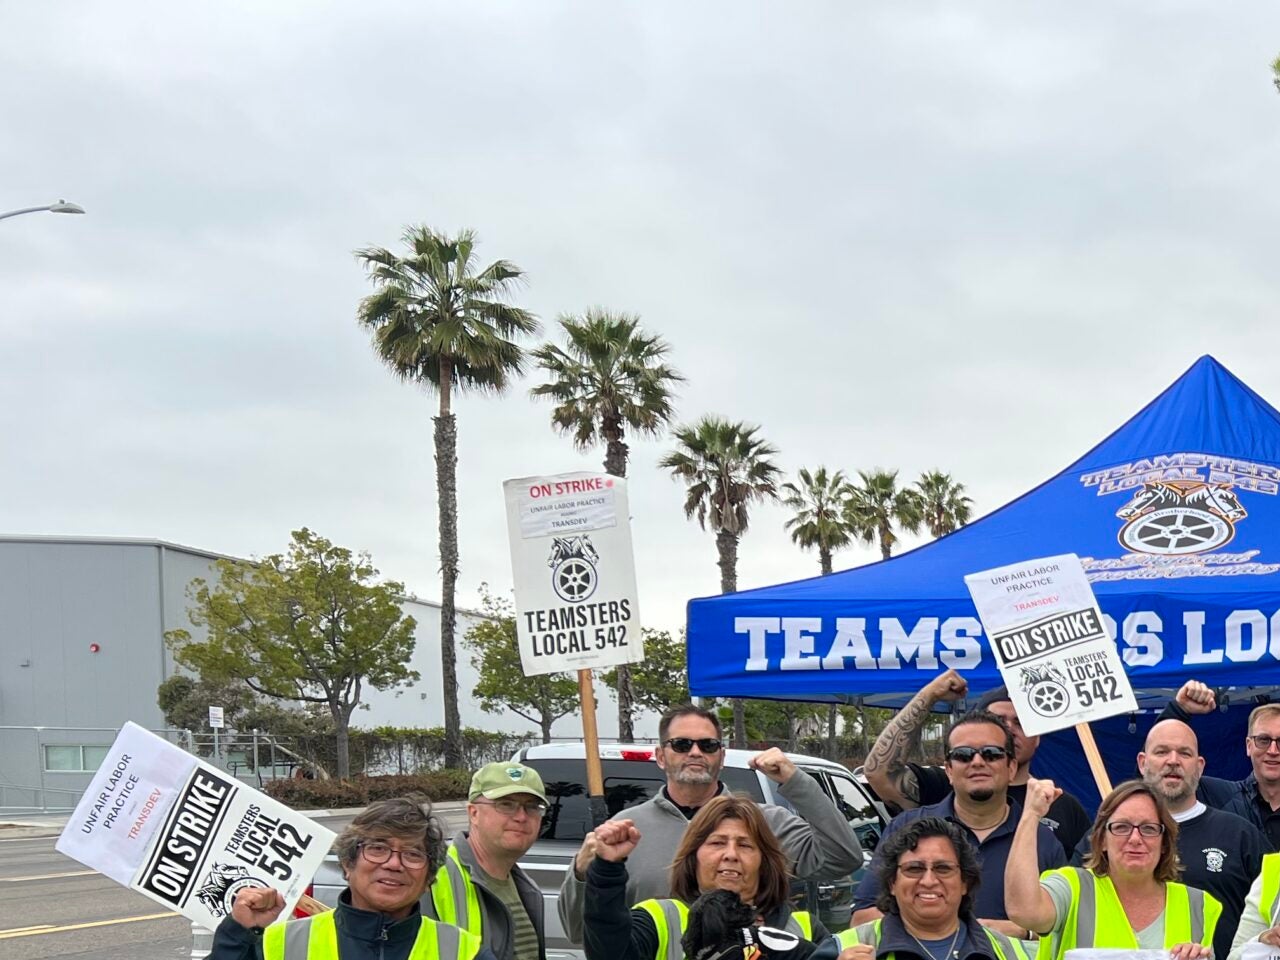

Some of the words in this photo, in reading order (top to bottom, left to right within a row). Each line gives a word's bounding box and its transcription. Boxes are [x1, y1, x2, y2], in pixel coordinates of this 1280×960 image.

[530, 484, 552, 498] ON
[555, 478, 603, 495] STRIKE
[1097, 468, 1205, 497] LOCAL
[1209, 470, 1278, 495] 542
[530, 505, 553, 513] UNFAIR
[554, 502, 575, 510] LABOR
[577, 498, 605, 506] PRACTICE
[552, 518, 587, 528] TRANSDEV
[991, 571, 1026, 586] UNFAIR
[1028, 564, 1060, 577] LABOR
[1006, 578, 1053, 593] PRACTICE
[524, 599, 631, 633] TEAMSTERS
[1014, 595, 1060, 612] TRANSDEV
[532, 630, 591, 656] LOCAL
[595, 625, 628, 650] 542
[734, 610, 1163, 671] TEAMSS
[1001, 634, 1028, 660] ON
[1031, 612, 1098, 653] STRIKE
[1063, 651, 1108, 667] TEAMSTERS
[1067, 660, 1113, 682] LOCAL
[1074, 676, 1123, 707] 542
[81, 792, 110, 834] UNFAIR
[105, 754, 132, 792] LABOR
[103, 774, 139, 829] PRACTICE
[128, 788, 161, 840] TRANSDEV
[167, 774, 226, 860] STRIKE
[224, 804, 261, 854] TEAMSTERS
[235, 814, 281, 866] LOCAL
[257, 823, 313, 881] 542
[151, 855, 189, 897] ON
